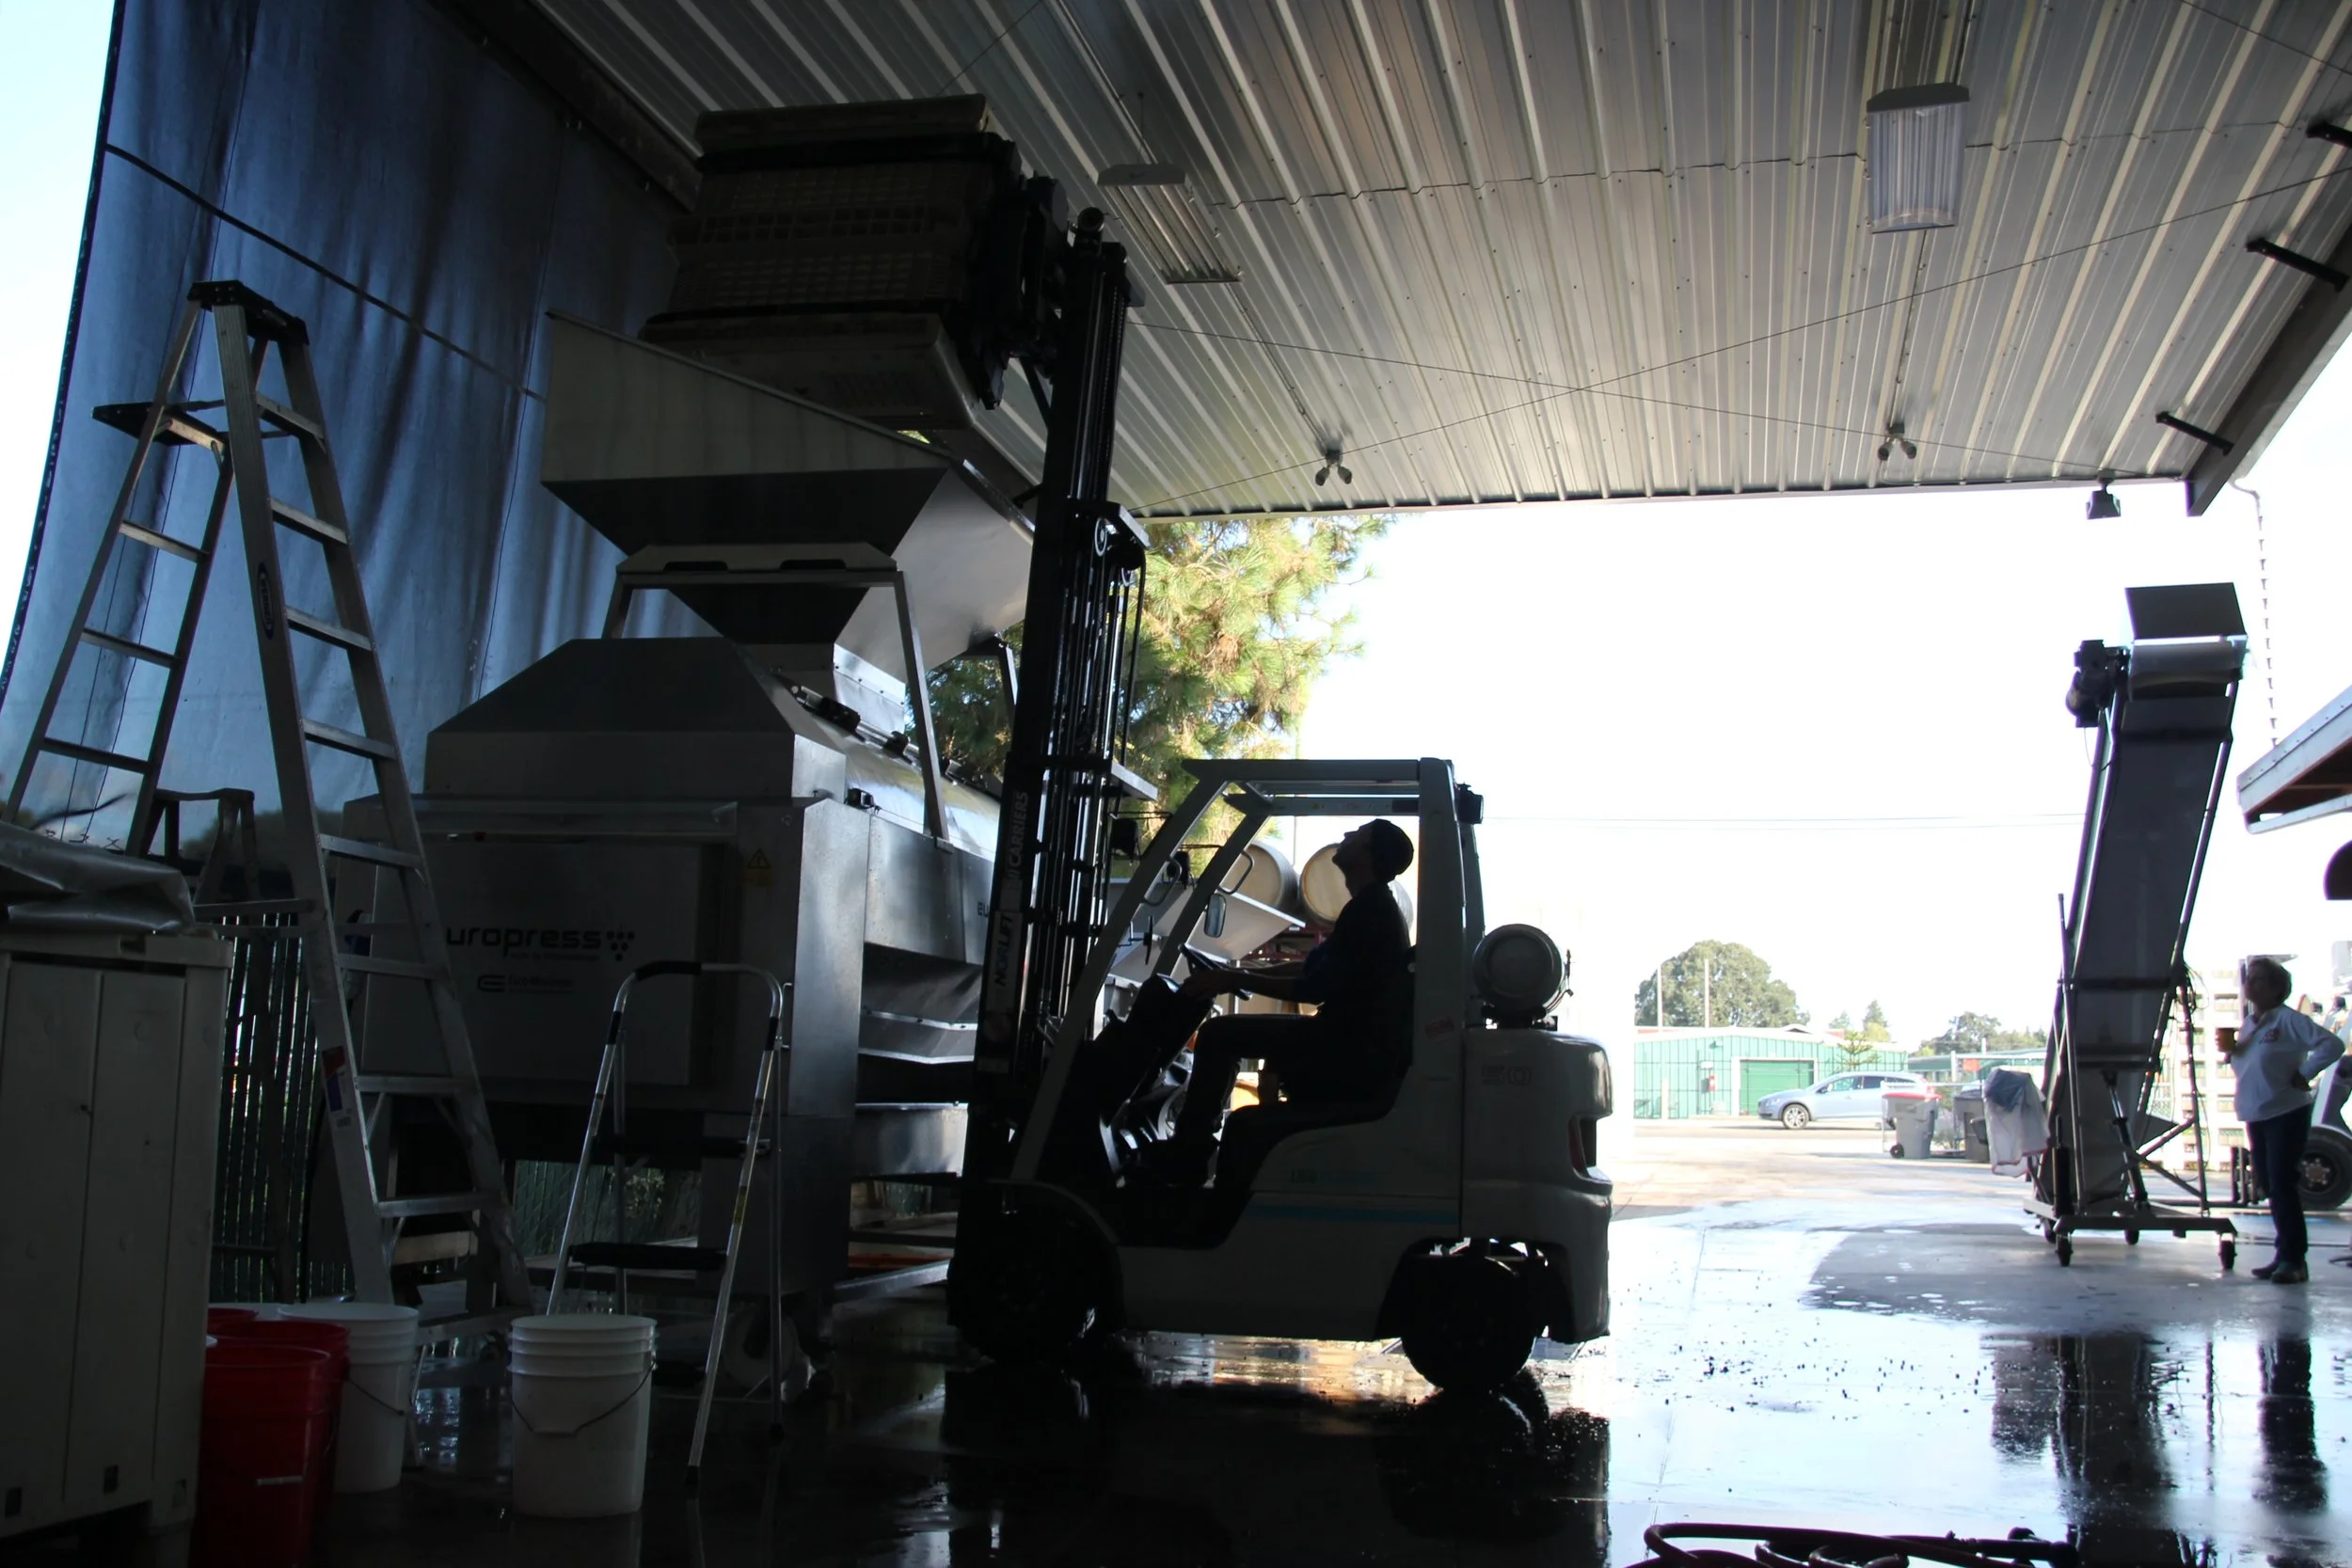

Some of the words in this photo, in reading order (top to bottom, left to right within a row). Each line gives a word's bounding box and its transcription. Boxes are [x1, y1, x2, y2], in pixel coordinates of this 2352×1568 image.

[1008, 790, 1029, 867] CARRIERS
[446, 927, 601, 958] uropress
[993, 913, 1013, 988] NORLIFT
[1481, 1064, 1533, 1086] 50
